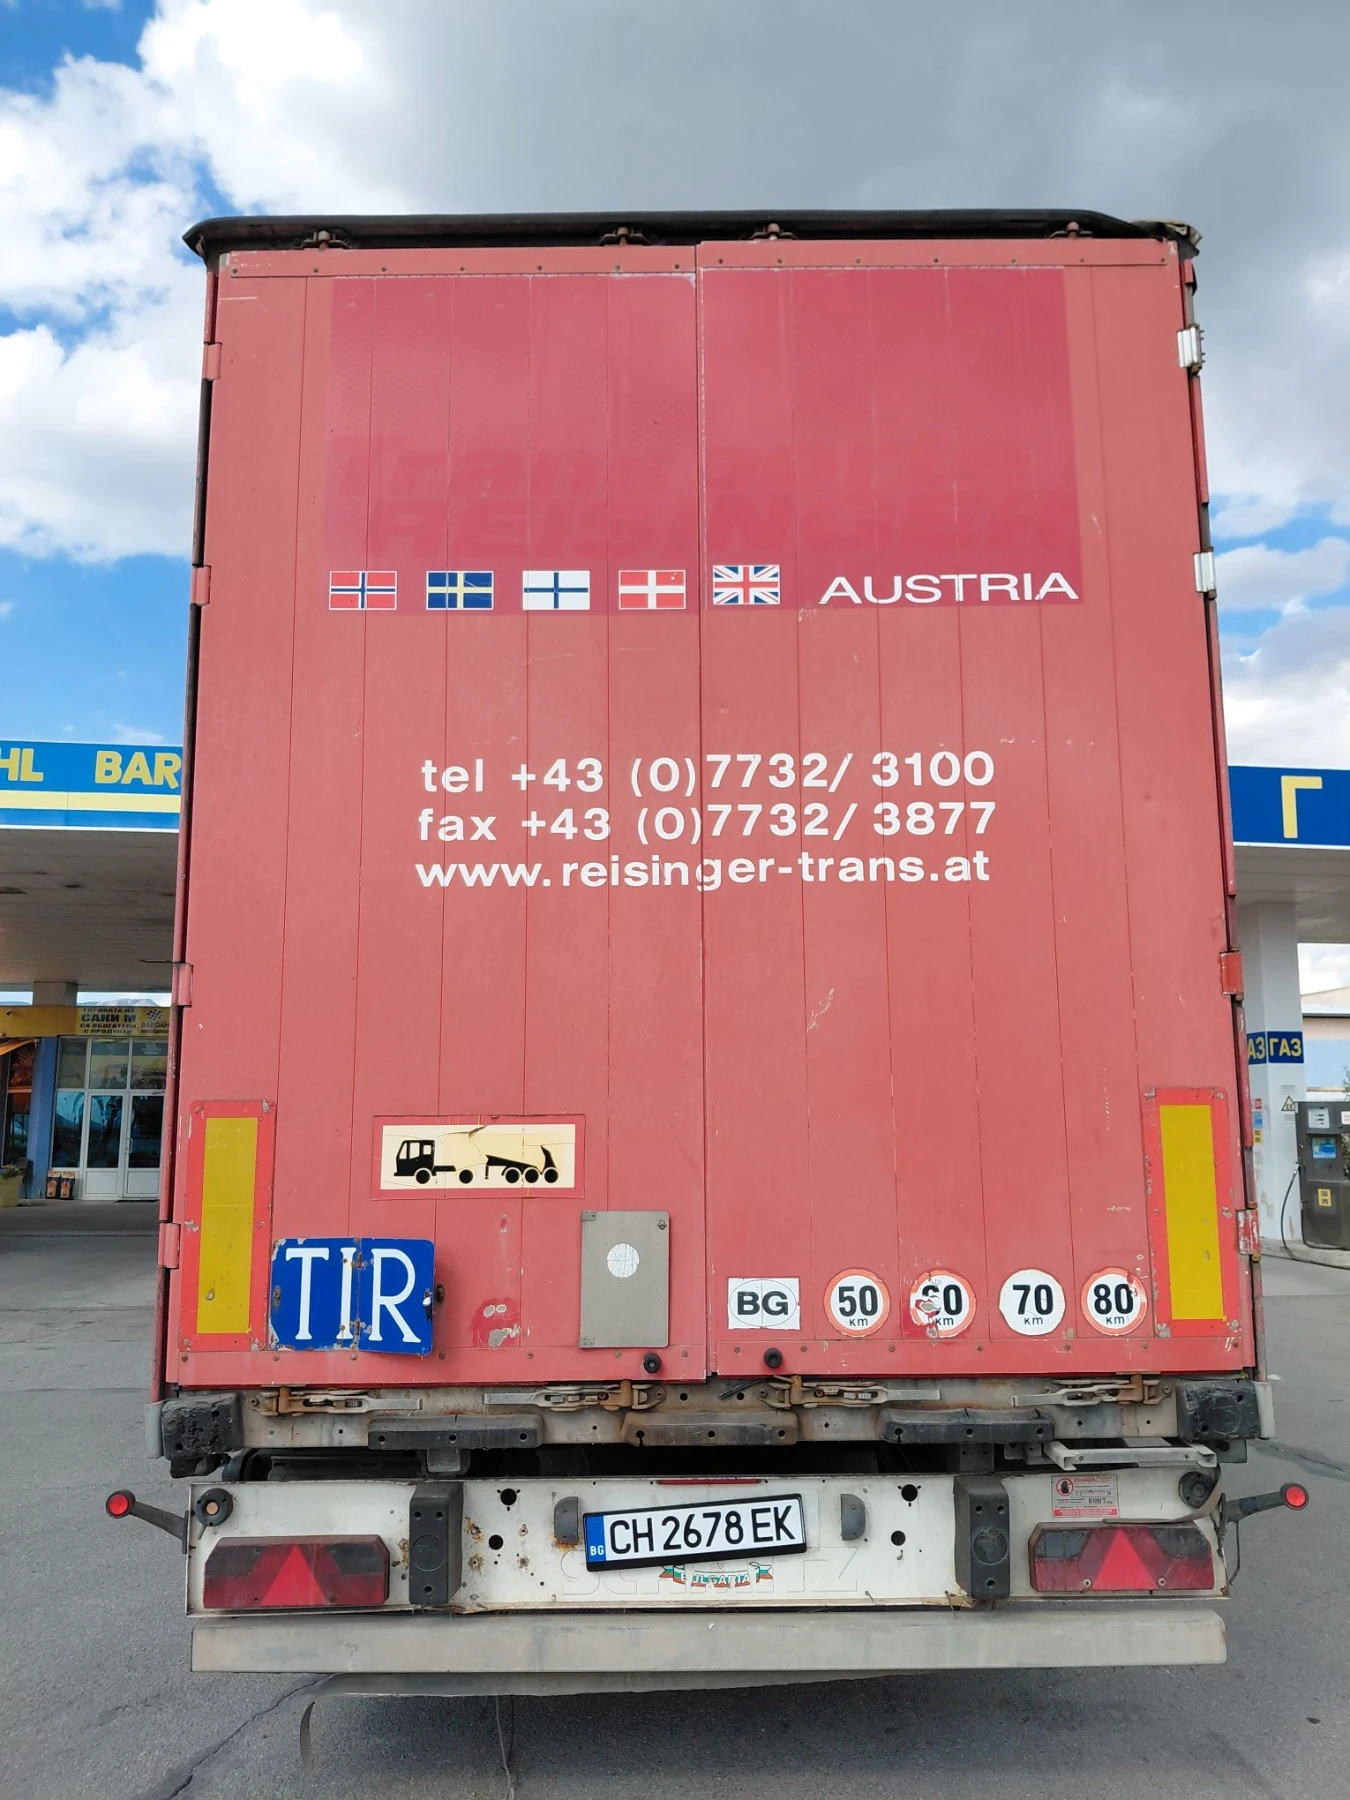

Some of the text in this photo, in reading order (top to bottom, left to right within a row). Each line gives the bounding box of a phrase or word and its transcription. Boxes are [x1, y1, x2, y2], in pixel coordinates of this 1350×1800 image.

[819, 572, 1080, 605] AUSTRIA
[95, 750, 181, 790] BAR
[421, 758, 484, 793] tel
[511, 757, 603, 793] +43
[871, 750, 995, 788] 3100
[418, 807, 497, 842] fax
[521, 807, 611, 841] +43
[872, 801, 996, 836] 3877
[415, 850, 990, 892] www.reisinger-trans.at
[81, 1014, 136, 1022] САКИ М
[1269, 1037, 1303, 1058] ГАЗ
[284, 1246, 422, 1343] TIR
[736, 1290, 789, 1316] BG
[837, 1284, 879, 1317] 50
[1012, 1283, 1054, 1315] 70
[1093, 1283, 1134, 1315] 80
[849, 1317, 869, 1327] km
[935, 1317, 954, 1326] km
[1024, 1316, 1044, 1325] km
[1106, 1315, 1125, 1325] km
[590, 1544, 605, 1557] BG
